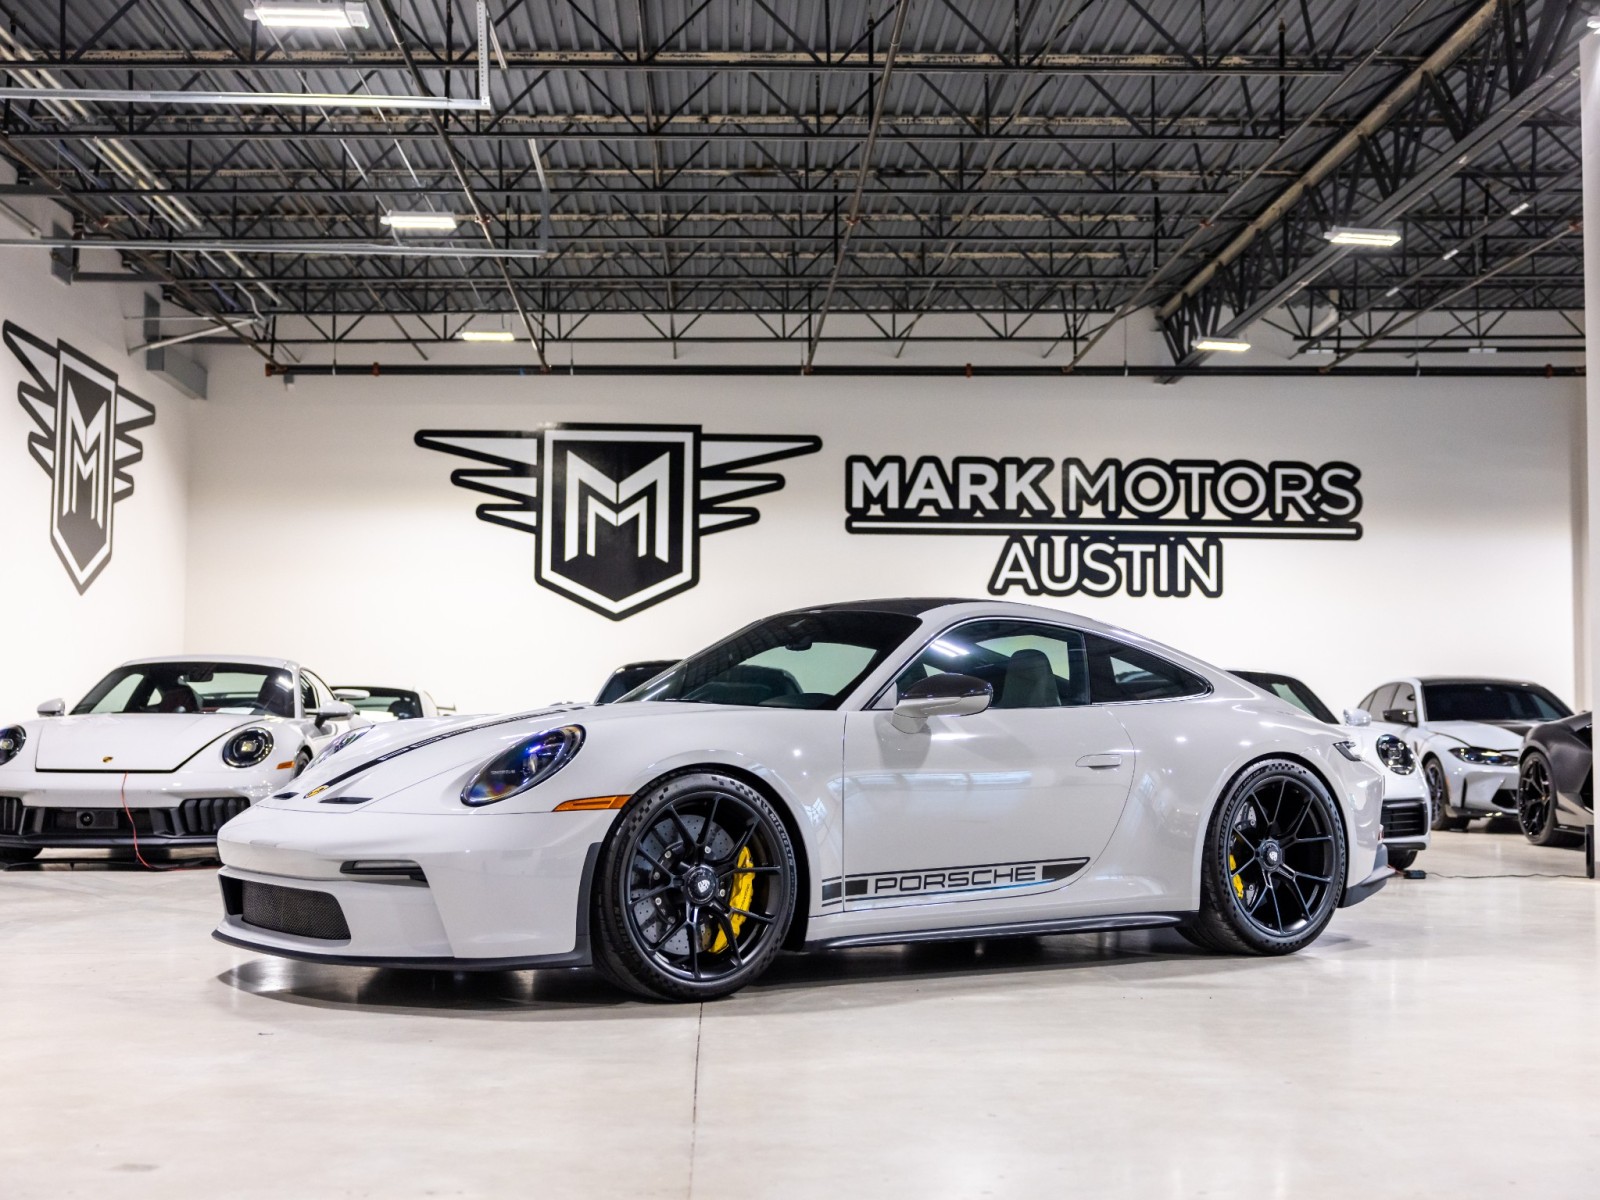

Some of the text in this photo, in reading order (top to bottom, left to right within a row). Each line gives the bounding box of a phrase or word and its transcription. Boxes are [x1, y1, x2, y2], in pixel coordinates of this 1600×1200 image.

[849, 461, 1359, 518] MARK MOTORS
[992, 541, 1219, 593] AUSTIN
[768, 811, 795, 867] MICHELIN
[1219, 798, 1235, 846] MICHELIN
[874, 865, 1037, 895] PORSCHE
